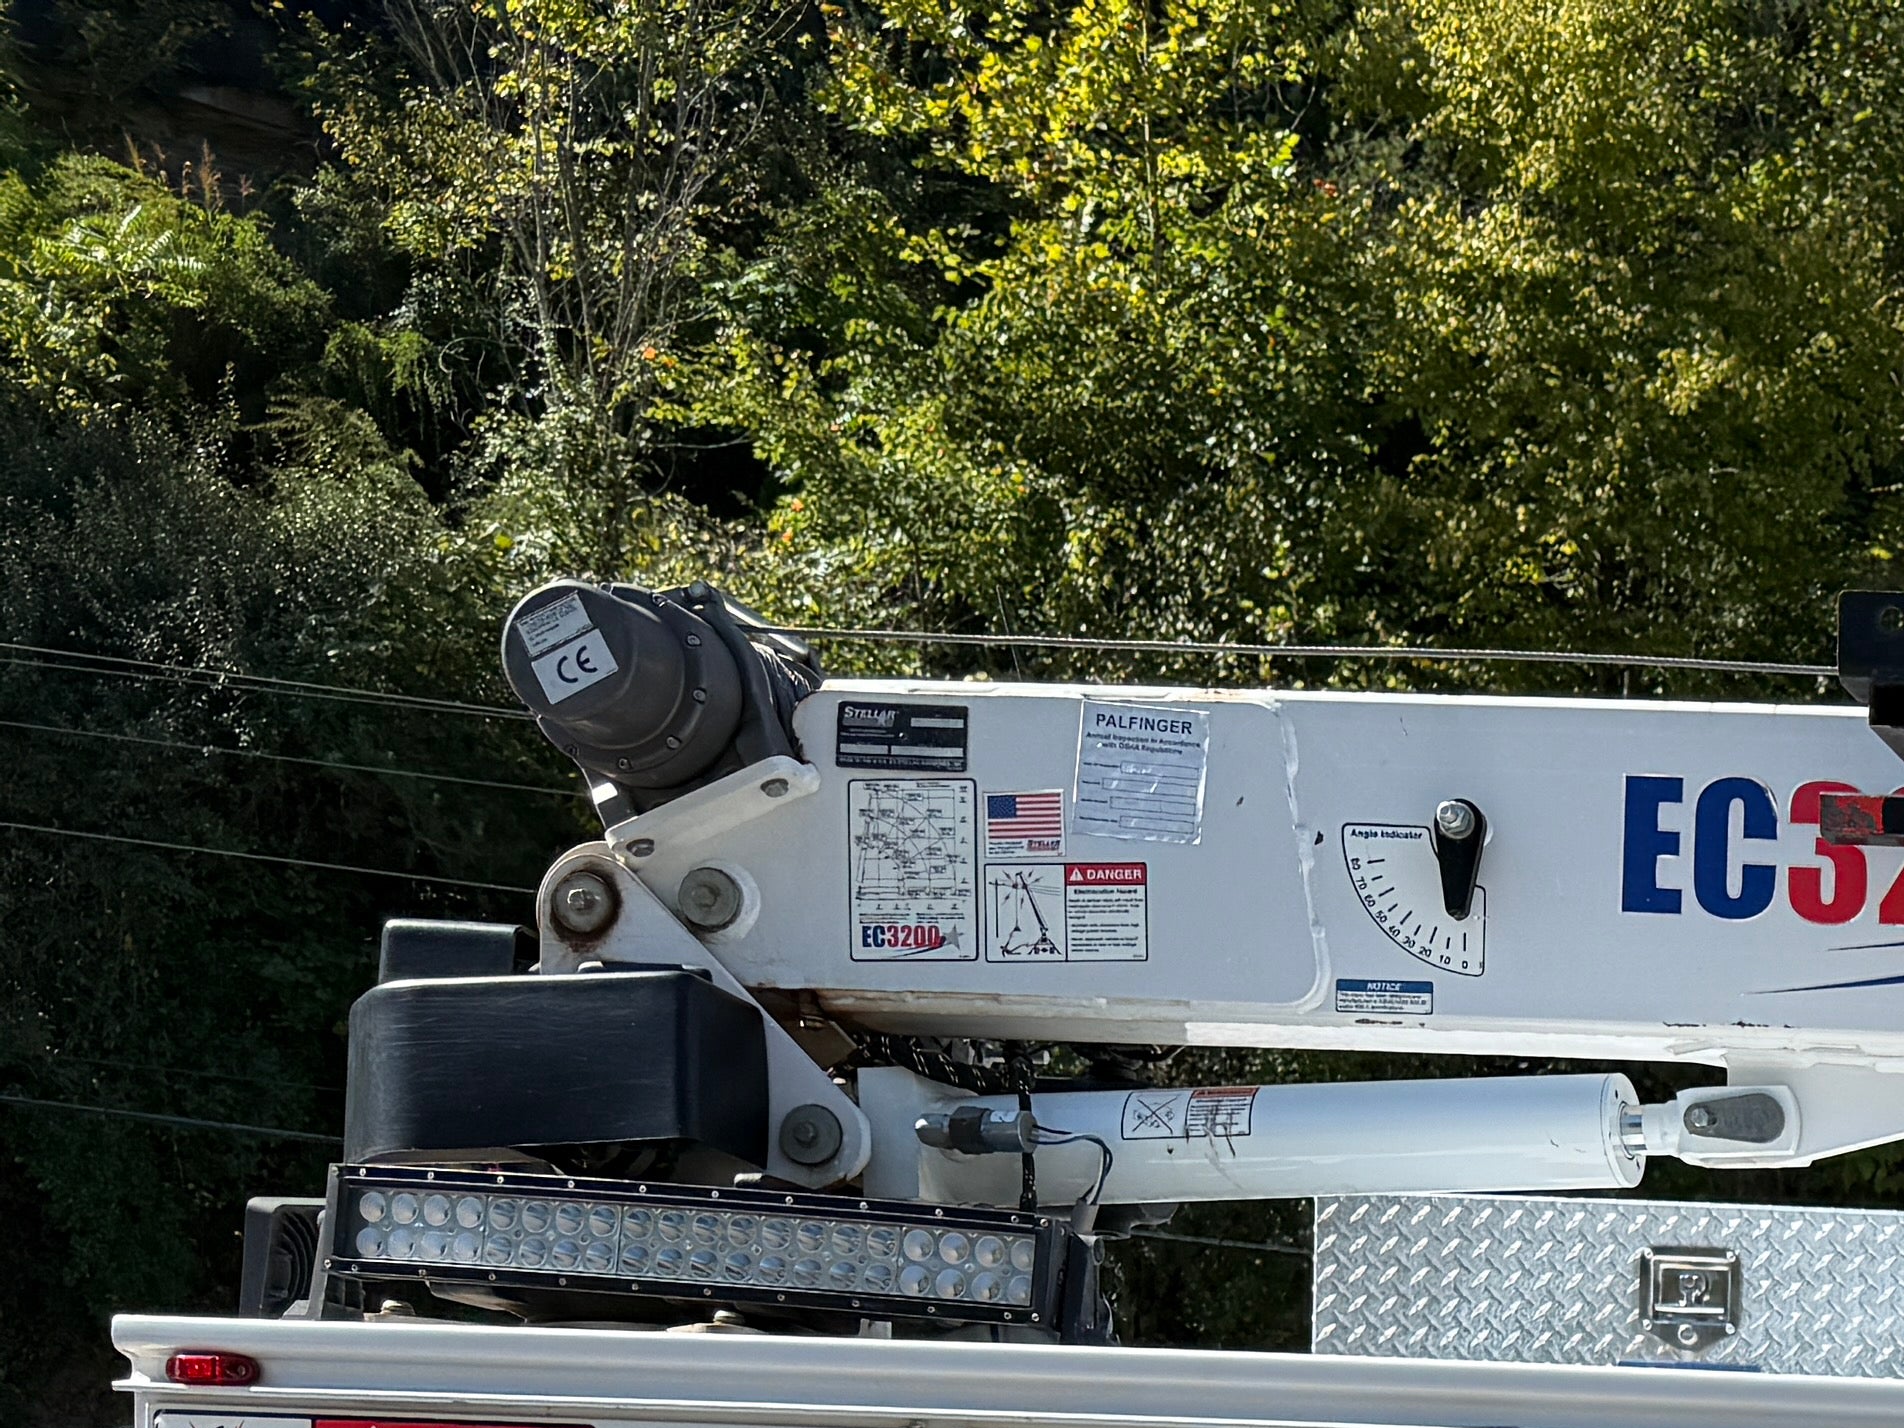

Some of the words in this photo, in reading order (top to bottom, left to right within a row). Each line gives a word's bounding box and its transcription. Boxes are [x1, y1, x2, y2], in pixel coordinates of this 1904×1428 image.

[1096, 713, 1192, 735] PALFINGER
[1086, 869, 1142, 880] DANGER
[1356, 876, 1368, 890] 70
[1374, 910, 1388, 923] 50
[862, 925, 941, 948] EC3200
[1388, 925, 1401, 937] 40
[1418, 946, 1432, 958] 20
[1439, 954, 1451, 965] 10
[1461, 960, 1468, 970] 0
